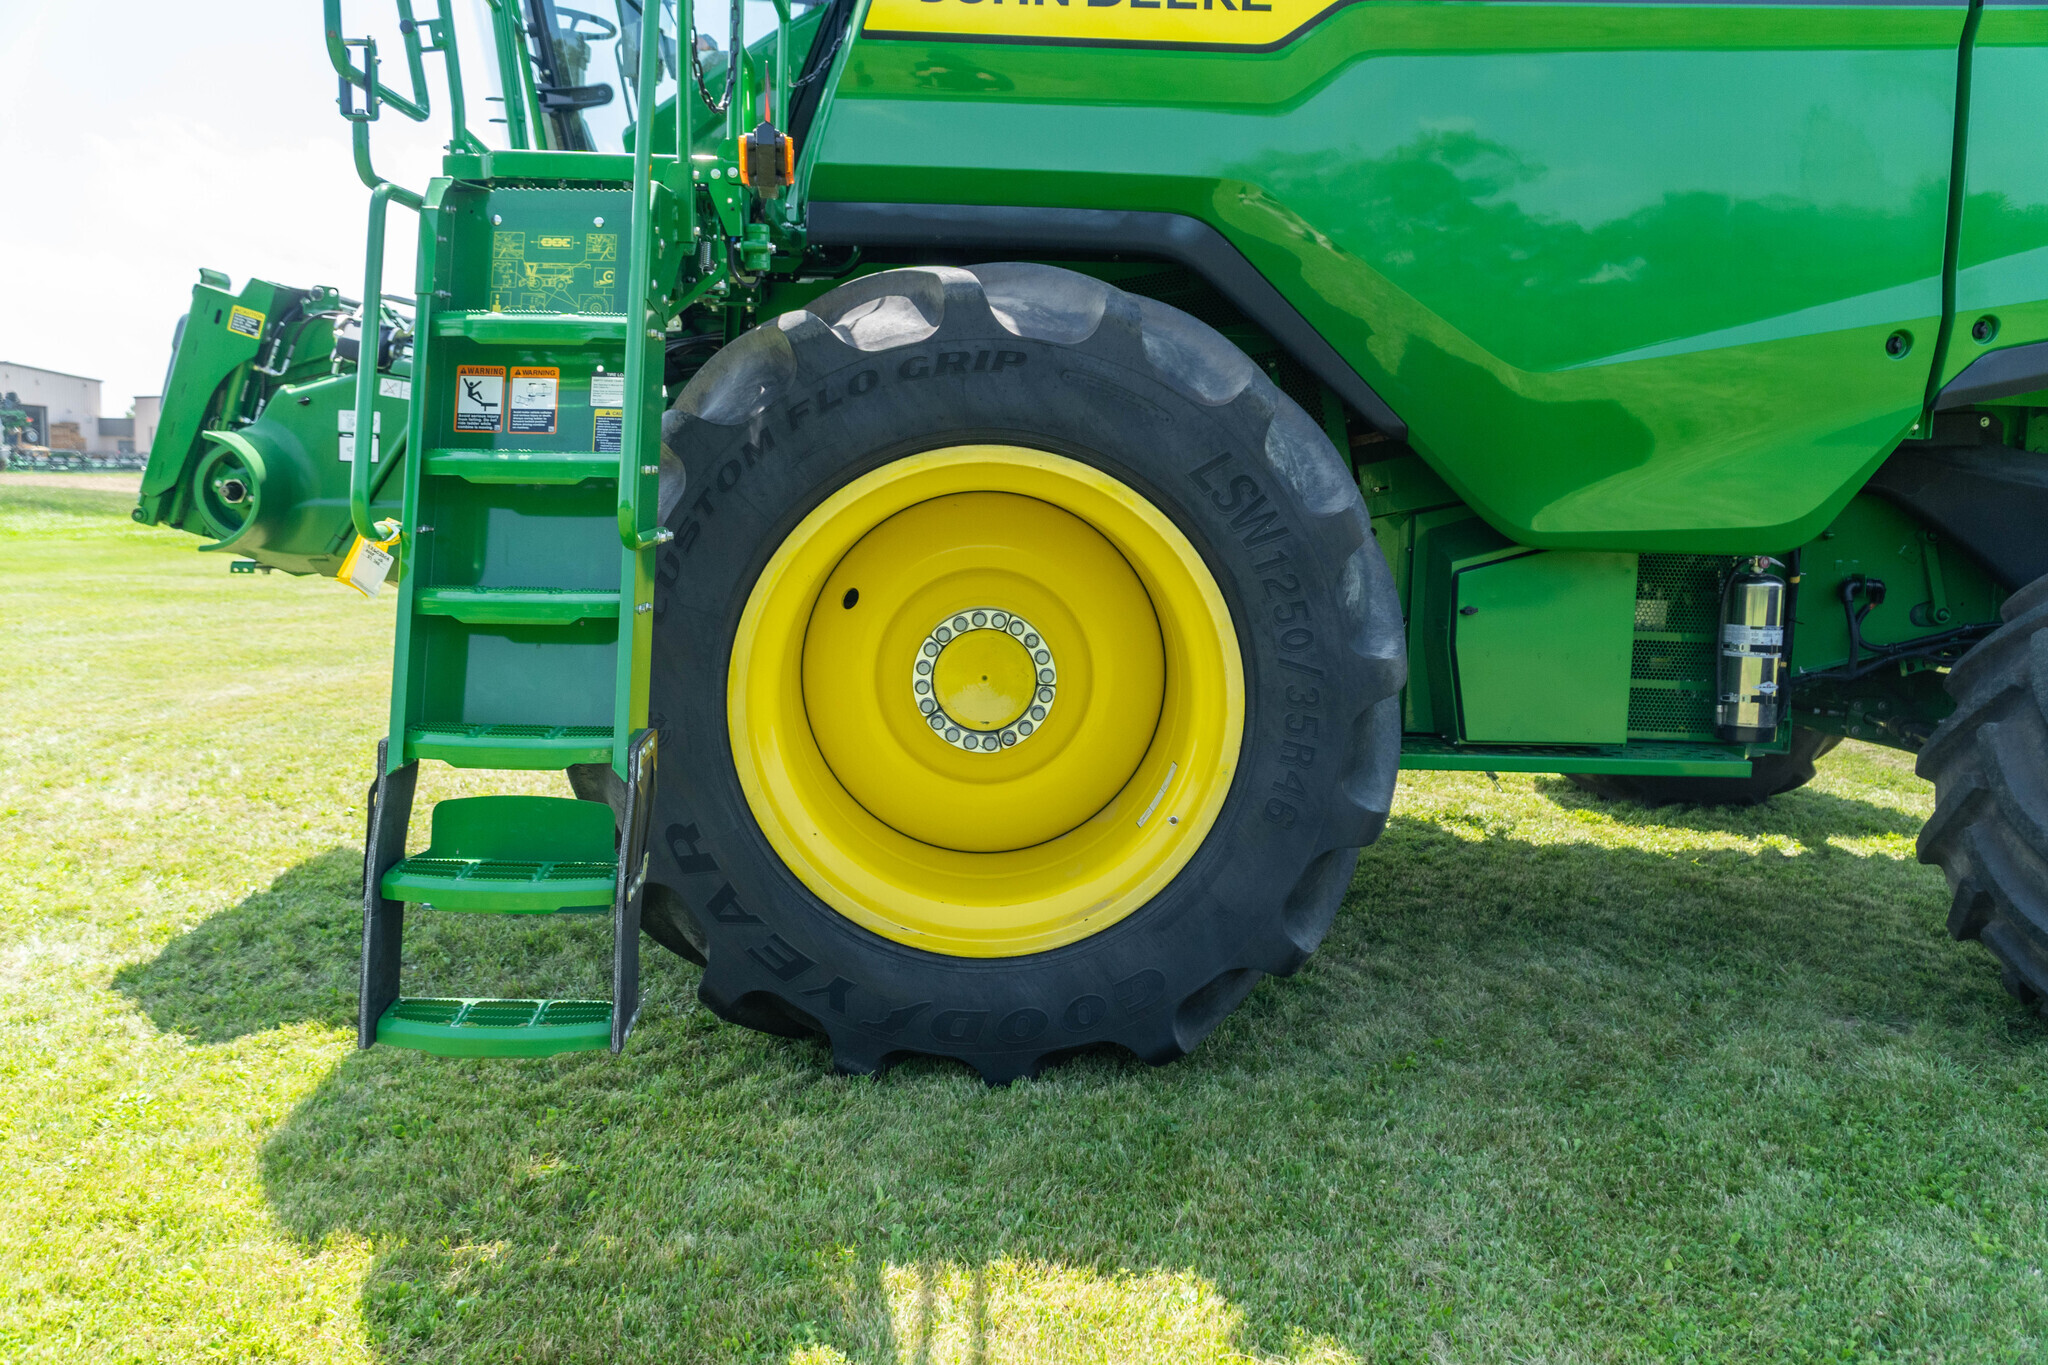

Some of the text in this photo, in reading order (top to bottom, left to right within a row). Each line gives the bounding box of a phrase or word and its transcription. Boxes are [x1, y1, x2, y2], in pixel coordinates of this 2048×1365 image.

[467, 367, 504, 375] WARNING
[786, 369, 879, 431] FLO
[898, 349, 1028, 381] GRIP
